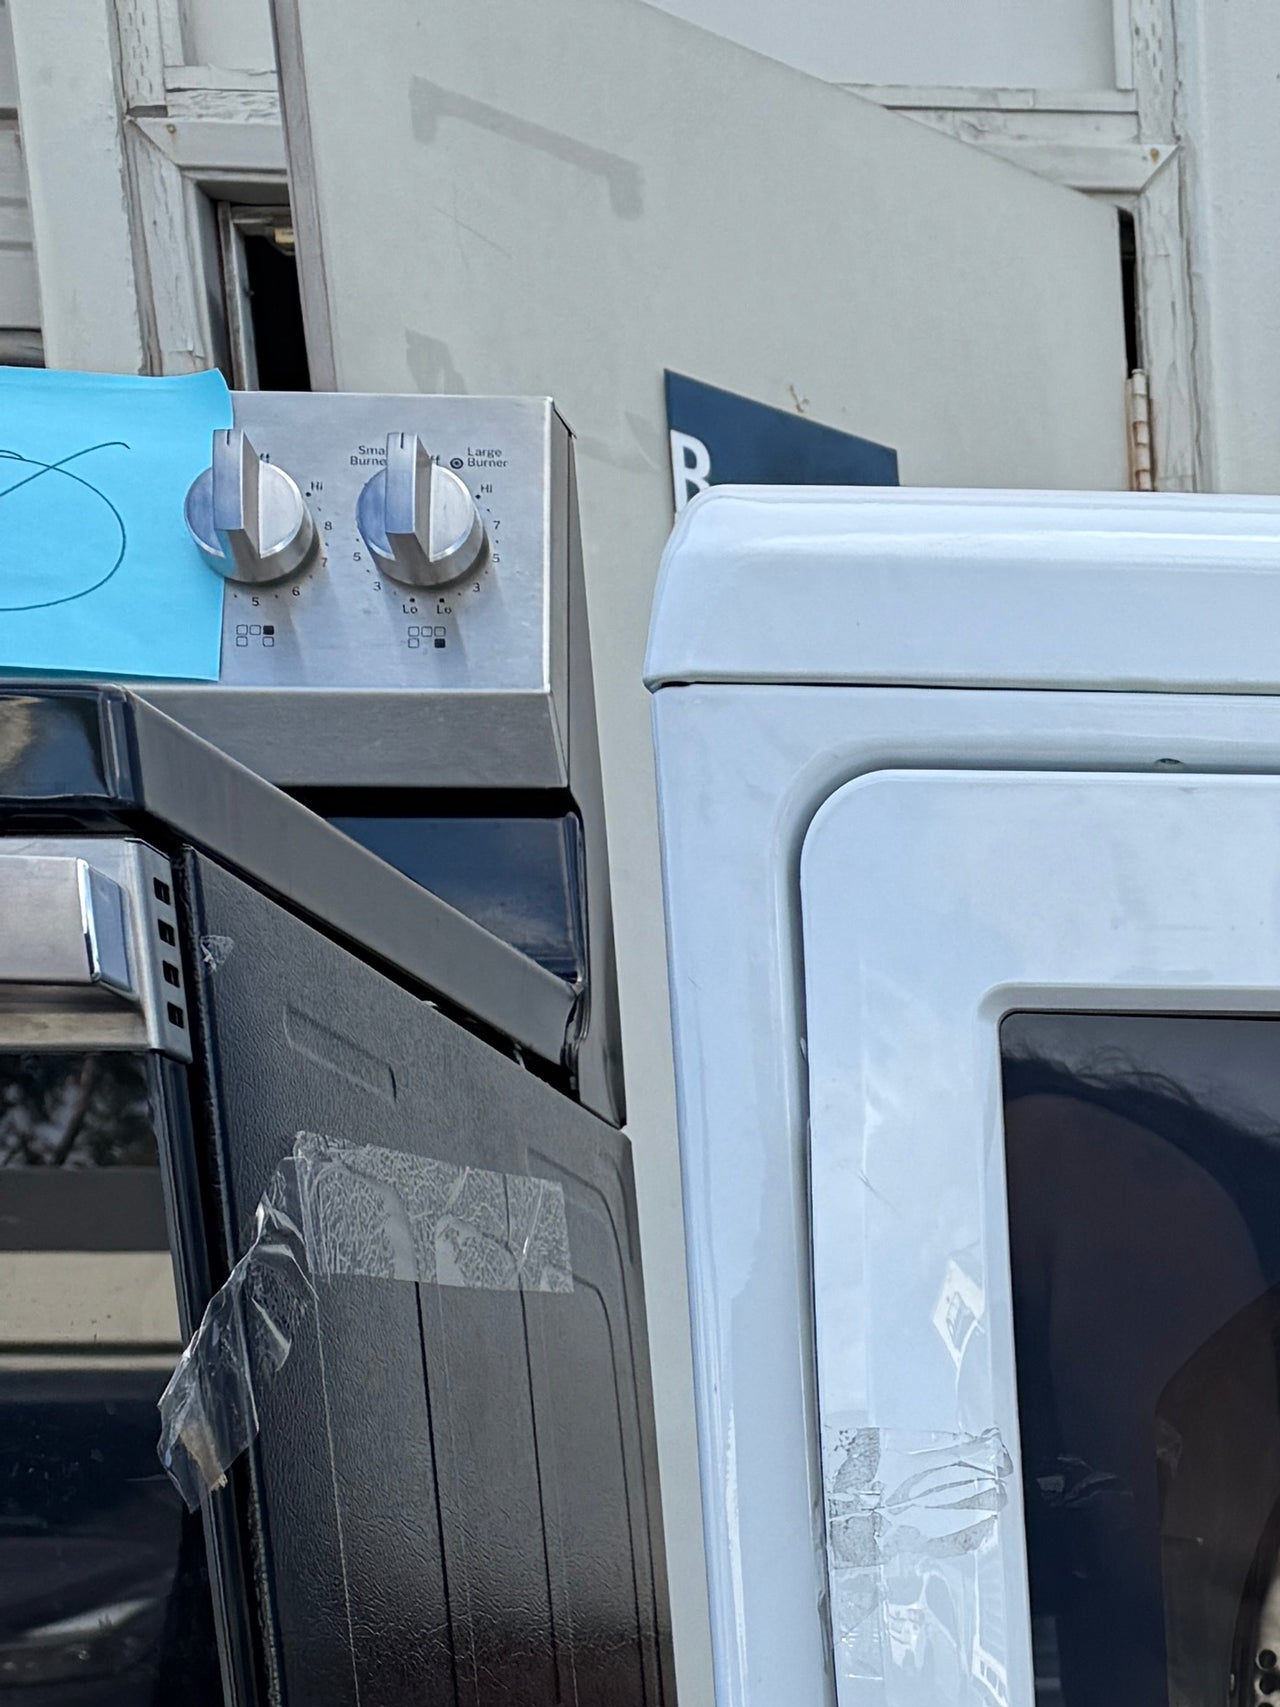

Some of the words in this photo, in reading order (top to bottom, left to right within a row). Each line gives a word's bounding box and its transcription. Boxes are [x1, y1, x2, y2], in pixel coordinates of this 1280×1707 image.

[358, 445, 386, 456] Sma
[467, 447, 503, 459] Large
[350, 455, 387, 467] Burne
[467, 458, 508, 468] Burner
[310, 481, 323, 492] Hi
[324, 521, 333, 531] 8
[493, 520, 501, 530] 7
[353, 552, 361, 562] 5
[492, 553, 501, 563] 5
[321, 558, 328, 568] 7
[292, 586, 301, 597] 6
[373, 582, 382, 592] 3
[472, 582, 481, 593] 3
[252, 596, 260, 607] 5
[402, 604, 419, 614] Lo
[436, 604, 453, 614] Lo
